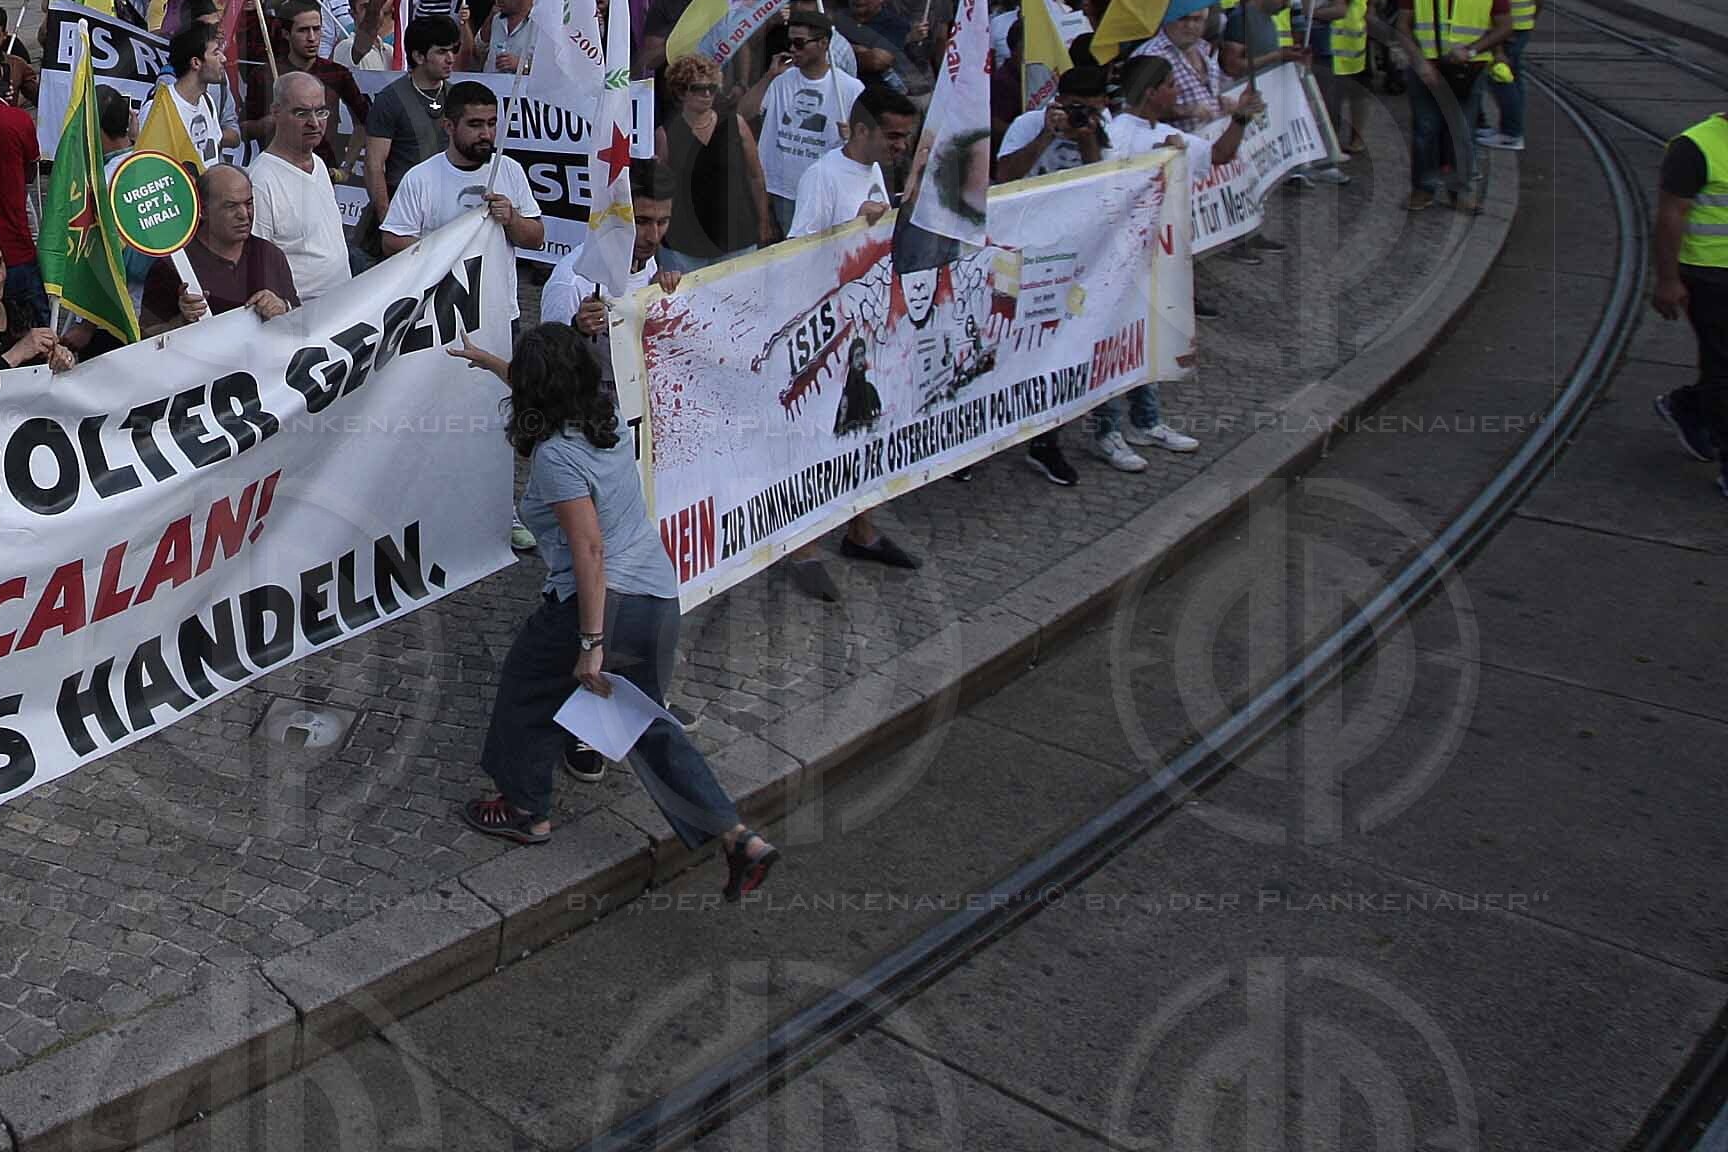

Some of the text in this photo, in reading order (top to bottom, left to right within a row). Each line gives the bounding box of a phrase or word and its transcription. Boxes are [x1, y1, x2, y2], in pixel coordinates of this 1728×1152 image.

[122, 175, 176, 205] URGENT:
[137, 196, 161, 215] CPT
[285, 254, 484, 414] GEGEN
[787, 300, 836, 375] ISIS
[660, 495, 715, 585] NEIN
[720, 505, 747, 561] ZUR
[747, 447, 860, 545] KRIMINALISIERUNG
[863, 437, 885, 482] DER
[990, 374, 1049, 431] POLITIKER
[1051, 361, 1090, 408] DURCH
[55, 520, 448, 758] HANDELN.
